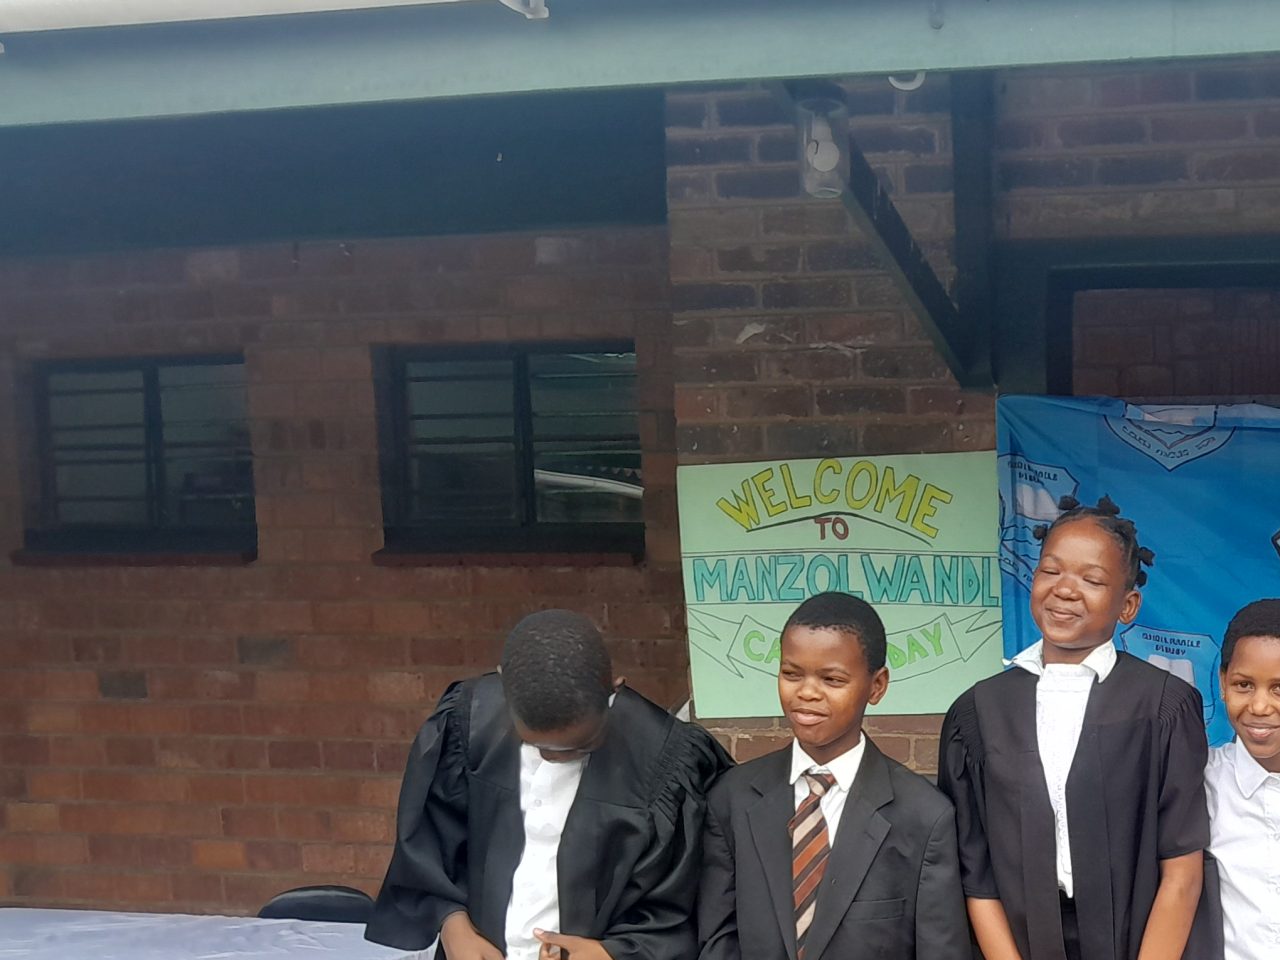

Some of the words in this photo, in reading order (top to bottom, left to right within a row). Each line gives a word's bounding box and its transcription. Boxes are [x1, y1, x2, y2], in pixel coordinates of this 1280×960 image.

[715, 458, 954, 539] WELCOME
[814, 517, 849, 540] TO
[692, 554, 1000, 607] MANZOLWANDL
[887, 622, 944, 670] DAY
